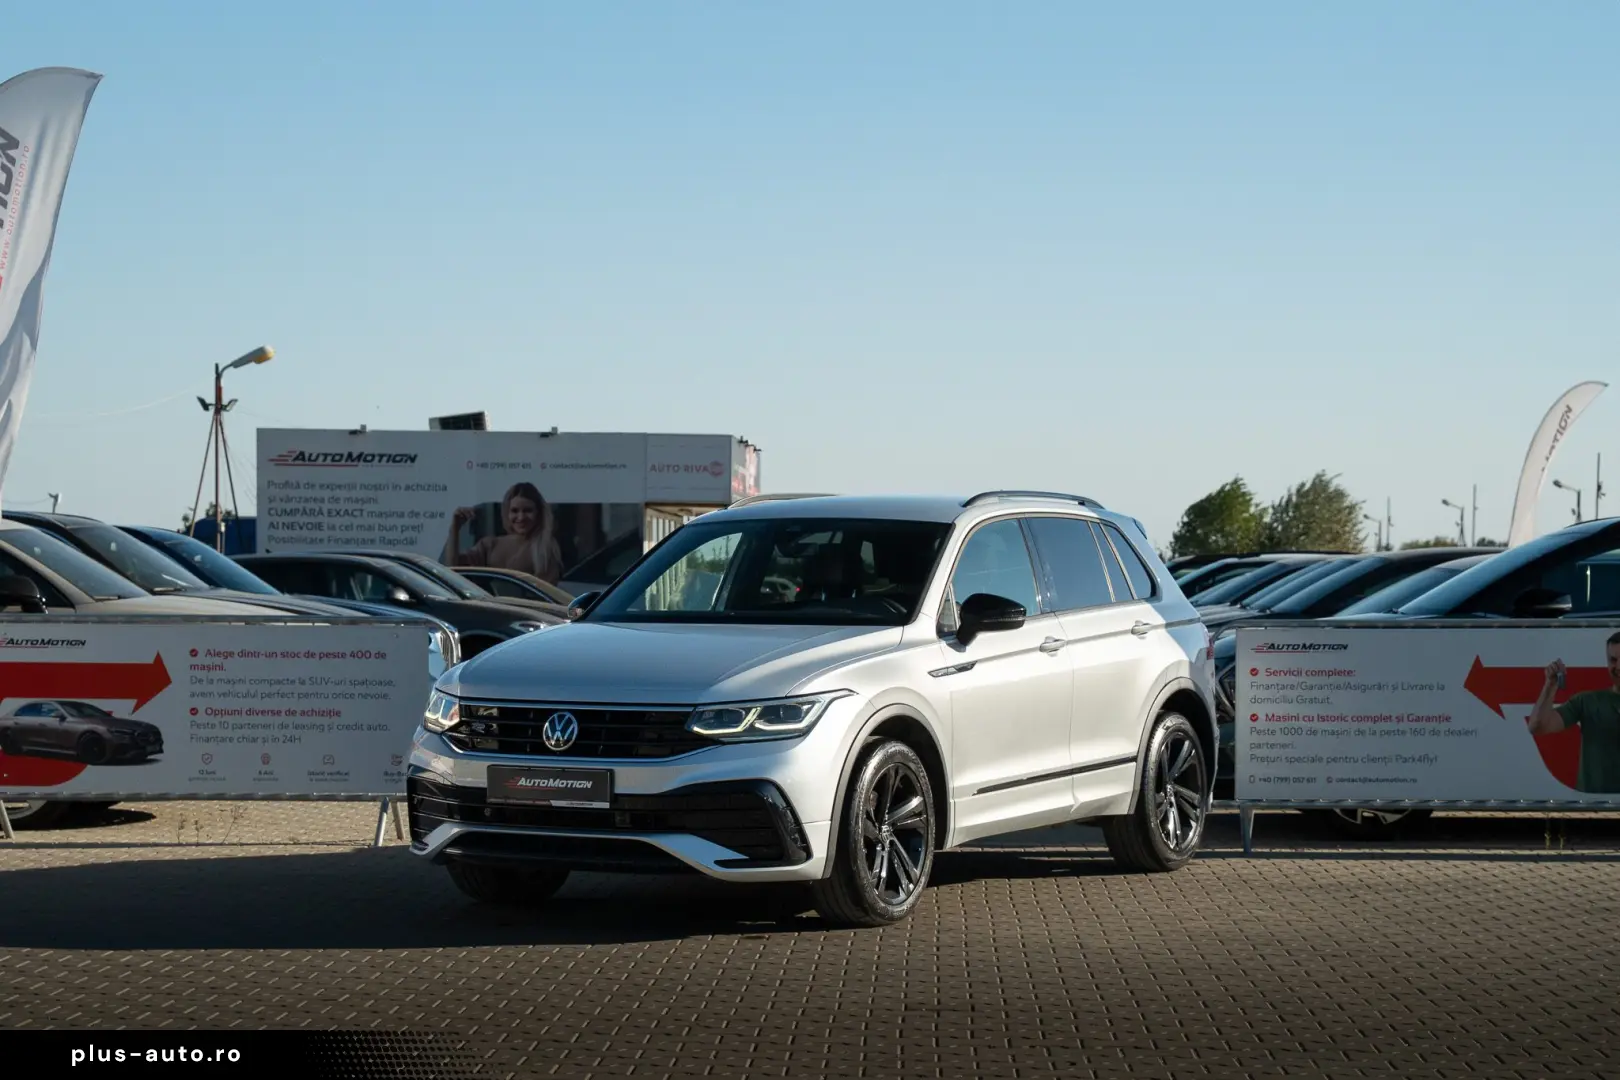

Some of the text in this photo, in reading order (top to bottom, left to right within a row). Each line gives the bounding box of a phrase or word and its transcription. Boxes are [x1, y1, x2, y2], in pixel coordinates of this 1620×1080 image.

[303, 481, 316, 490] de
[327, 495, 341, 504] de
[327, 508, 364, 517] EXACT
[407, 510, 421, 519] de
[423, 511, 445, 519] care
[282, 521, 324, 531] NEVOIE
[378, 522, 398, 532] bun
[205, 649, 387, 661] Alege dintr-un stoc de peste 400 de
[1265, 668, 1356, 679] Servicii complete:
[190, 676, 204, 685] De
[206, 676, 214, 685] la
[250, 677, 296, 688] compacte
[299, 677, 306, 686] la
[309, 677, 346, 686] SUV-uri
[1401, 683, 1433, 691] Livrare
[1436, 683, 1445, 691] la
[190, 690, 215, 698] avem
[218, 689, 259, 699] vehiculul
[261, 690, 295, 700] perfect
[298, 691, 330, 700] pentru
[332, 691, 355, 700] orice
[1250, 695, 1293, 705] domiciliu
[245, 707, 282, 717] diverse
[285, 707, 298, 717] de
[1317, 714, 1349, 722] Istoric
[1351, 714, 1393, 724] complet
[190, 721, 217, 730] Peste
[219, 721, 229, 730] 10
[232, 722, 275, 732] parteneri
[280, 722, 290, 731] de
[292, 722, 325, 733] leasing
[337, 722, 364, 731] credit
[1250, 727, 1276, 736] Peste
[1279, 727, 1303, 736] 1000
[1306, 728, 1318, 736] de
[1354, 728, 1366, 737] de
[1369, 728, 1376, 737] la
[1380, 728, 1407, 738] peste
[1409, 728, 1426, 737] 160
[1429, 728, 1441, 737] de
[1443, 728, 1477, 737] dealeri
[237, 734, 259, 744] chiar
[282, 735, 301, 744] 24H
[1285, 754, 1323, 765] speciale
[1326, 755, 1358, 765] pentru
